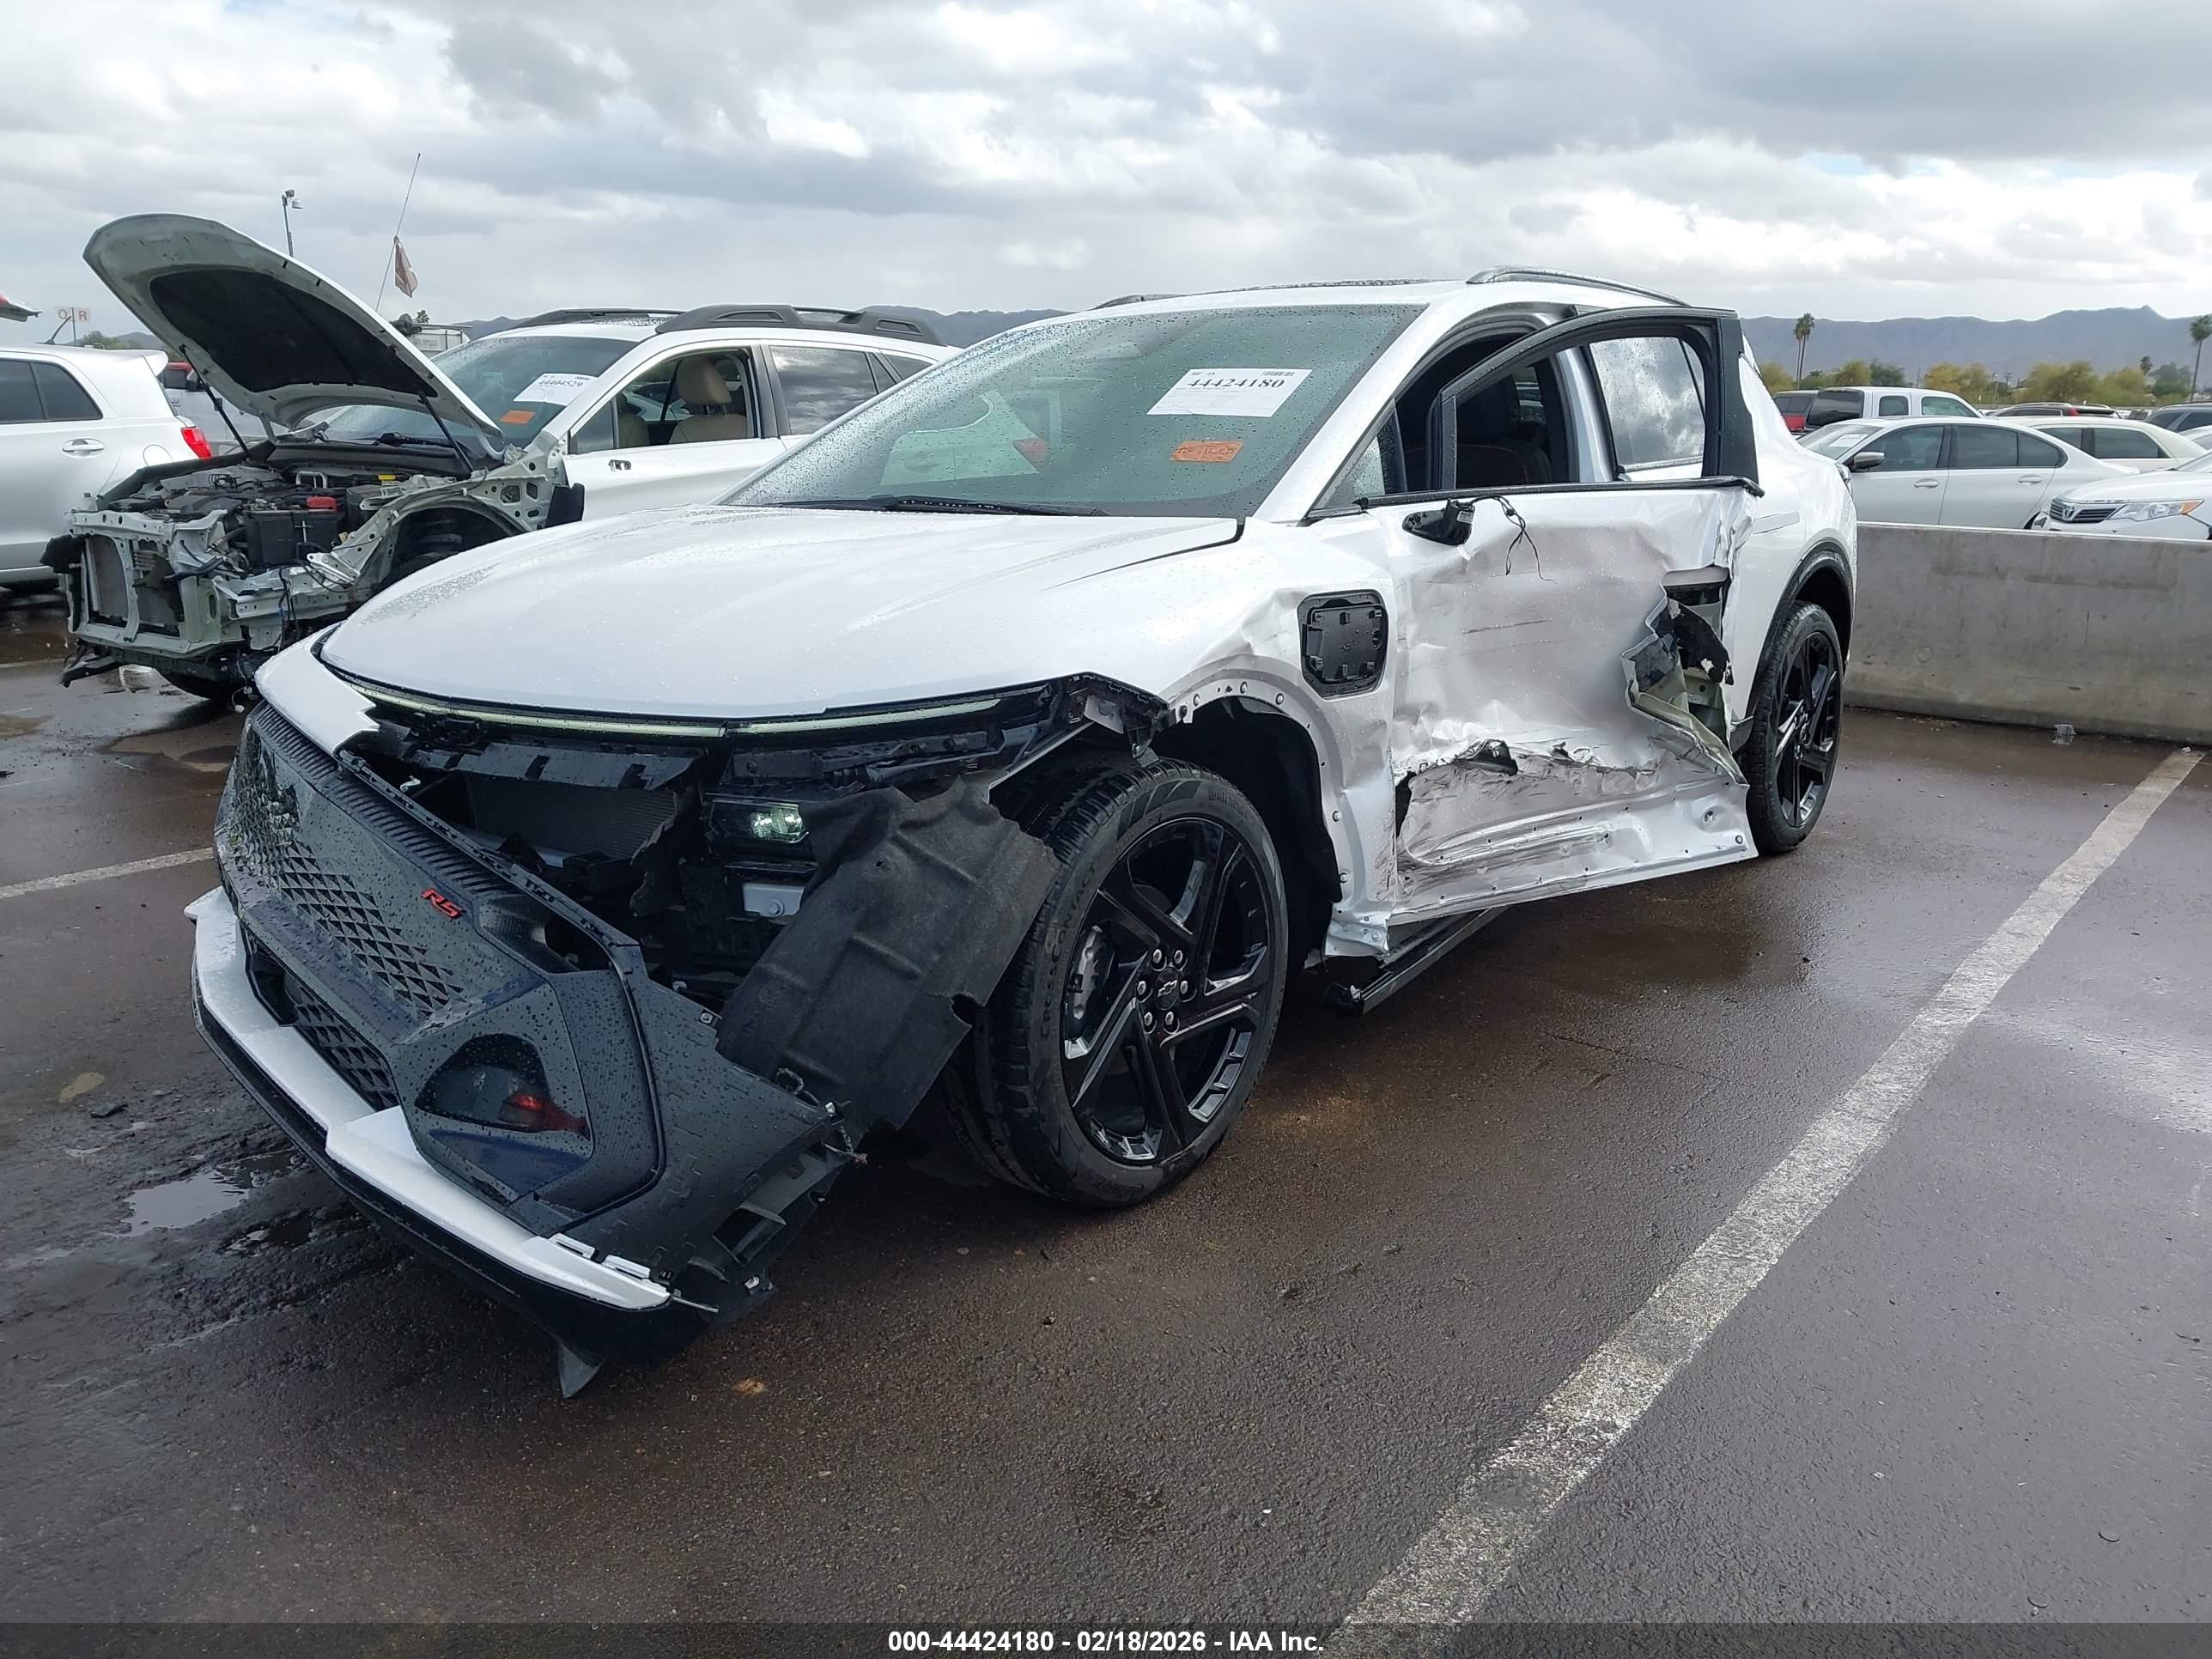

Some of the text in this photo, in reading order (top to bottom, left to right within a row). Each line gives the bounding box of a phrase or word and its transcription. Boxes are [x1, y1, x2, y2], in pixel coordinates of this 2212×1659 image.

[78, 310, 88, 321] R
[1187, 378, 1286, 389] 44424180
[422, 888, 463, 918] RS
